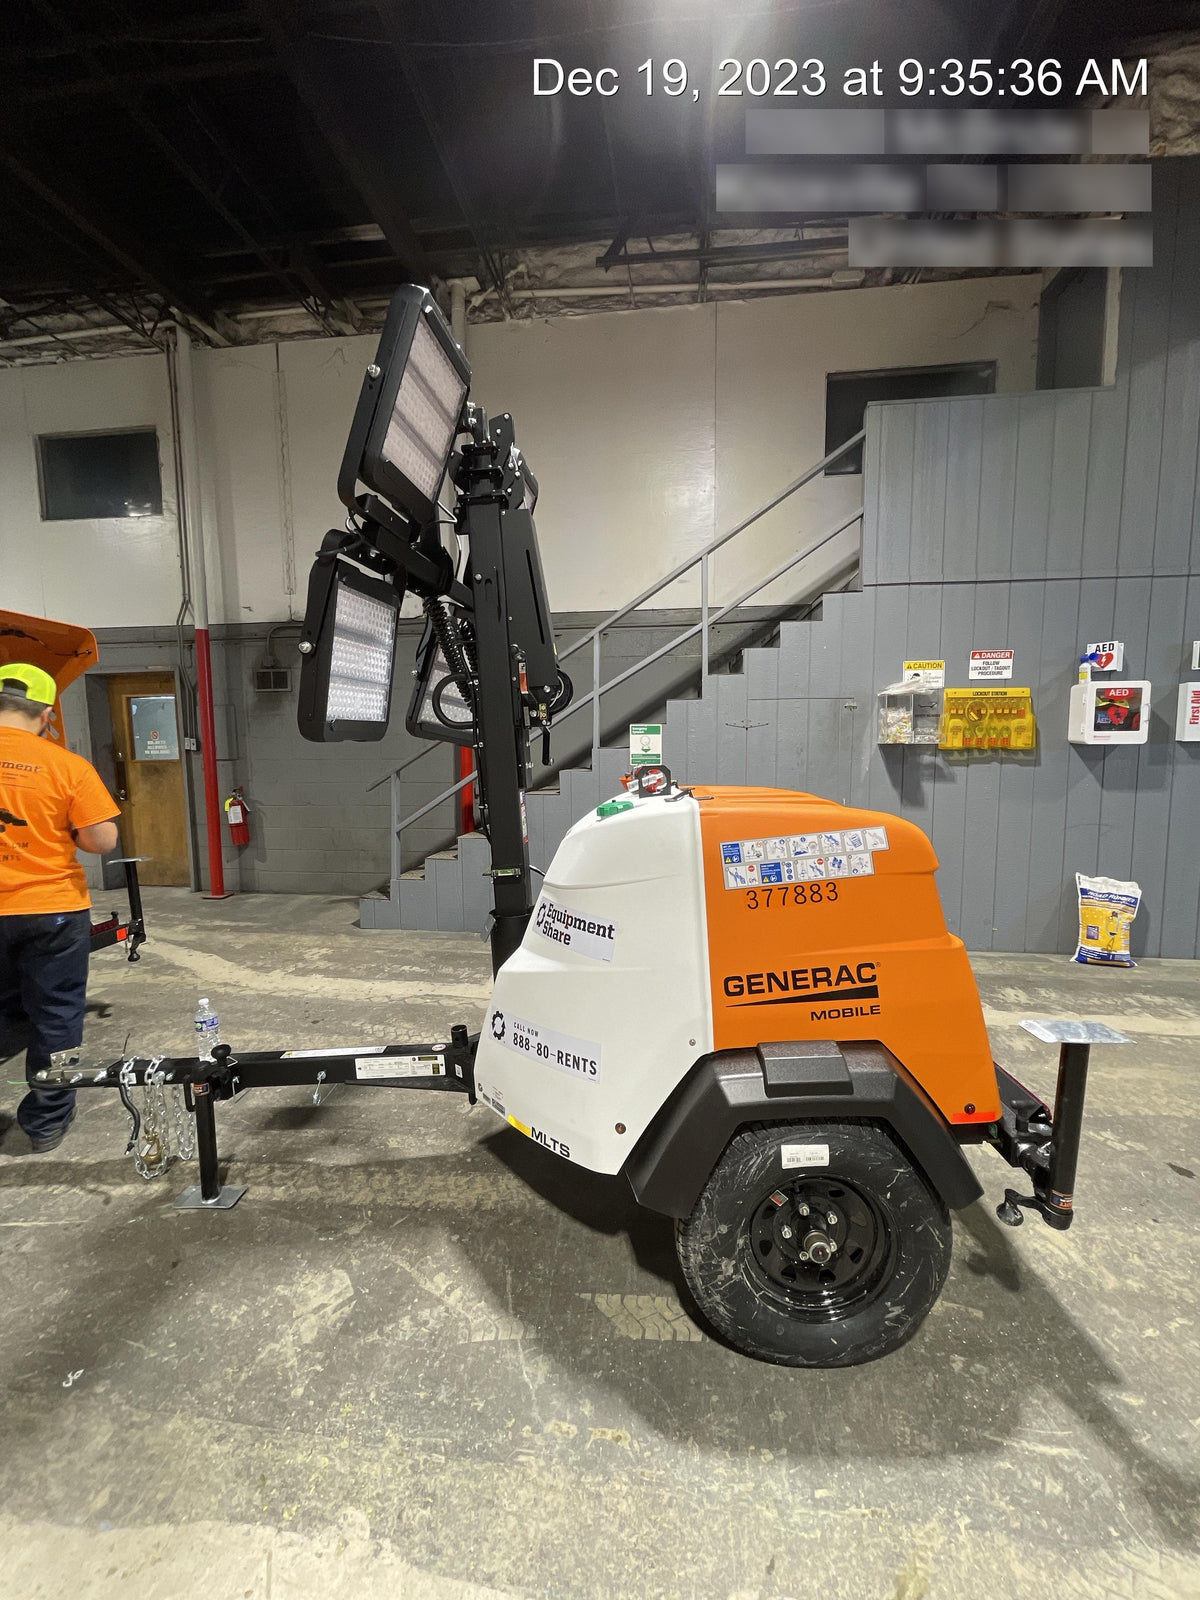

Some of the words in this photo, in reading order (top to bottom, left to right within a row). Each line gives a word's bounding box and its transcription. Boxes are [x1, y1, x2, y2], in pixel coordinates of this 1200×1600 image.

[1095, 642, 1115, 653] AED
[1108, 688, 1129, 696] AED
[1189, 706, 1200, 725] First
[746, 882, 839, 910] 377883
[542, 920, 571, 946] Share
[547, 903, 616, 940] Equipment
[723, 962, 878, 997] GENERAC
[811, 1005, 881, 1021] MOBILE
[513, 1022, 526, 1032] CALL
[527, 1028, 539, 1037] NOW
[513, 1032, 597, 1076] 888-80-RENTS
[531, 1126, 570, 1158] MLTS
